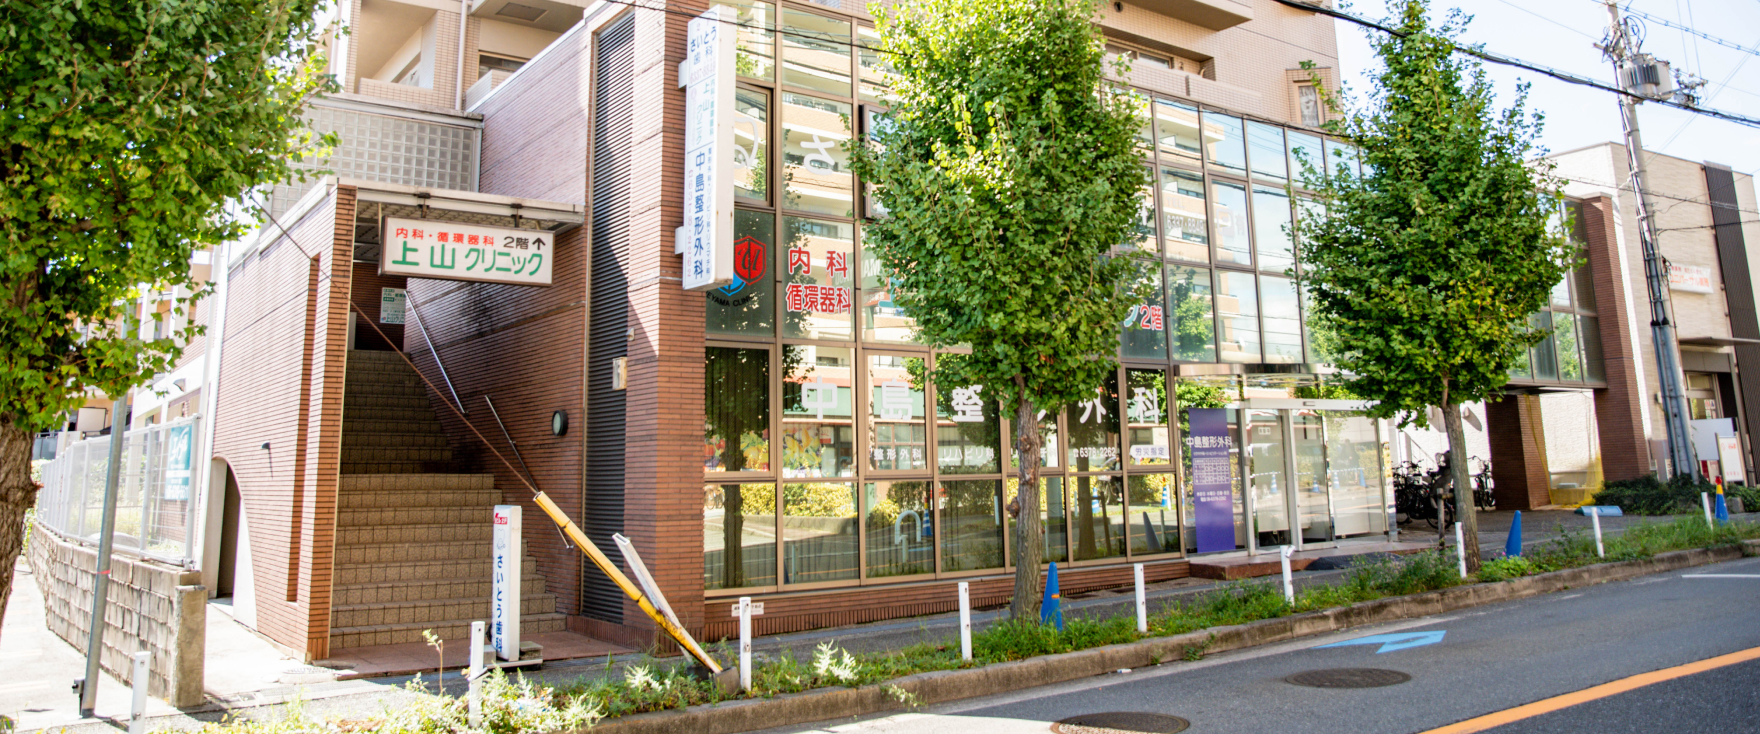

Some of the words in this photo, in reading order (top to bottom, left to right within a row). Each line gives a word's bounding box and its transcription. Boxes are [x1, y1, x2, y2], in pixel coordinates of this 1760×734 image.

[690, 26, 716, 52] さいとう
[703, 82, 710, 111] 上山
[694, 151, 704, 280] 中島整形外科
[396, 227, 494, 247] 内科・循環器科
[503, 235, 530, 250] 2階
[391, 240, 543, 276] 上山クリニック
[788, 246, 848, 278] 内科
[786, 283, 852, 314] 循環器科
[1141, 304, 1163, 330] 2階
[873, 448, 922, 461] 整形外科
[1134, 446, 1165, 457] 労災指定
[1186, 435, 1232, 449] 中島整形外科
[495, 554, 504, 653] さいとう歯科
